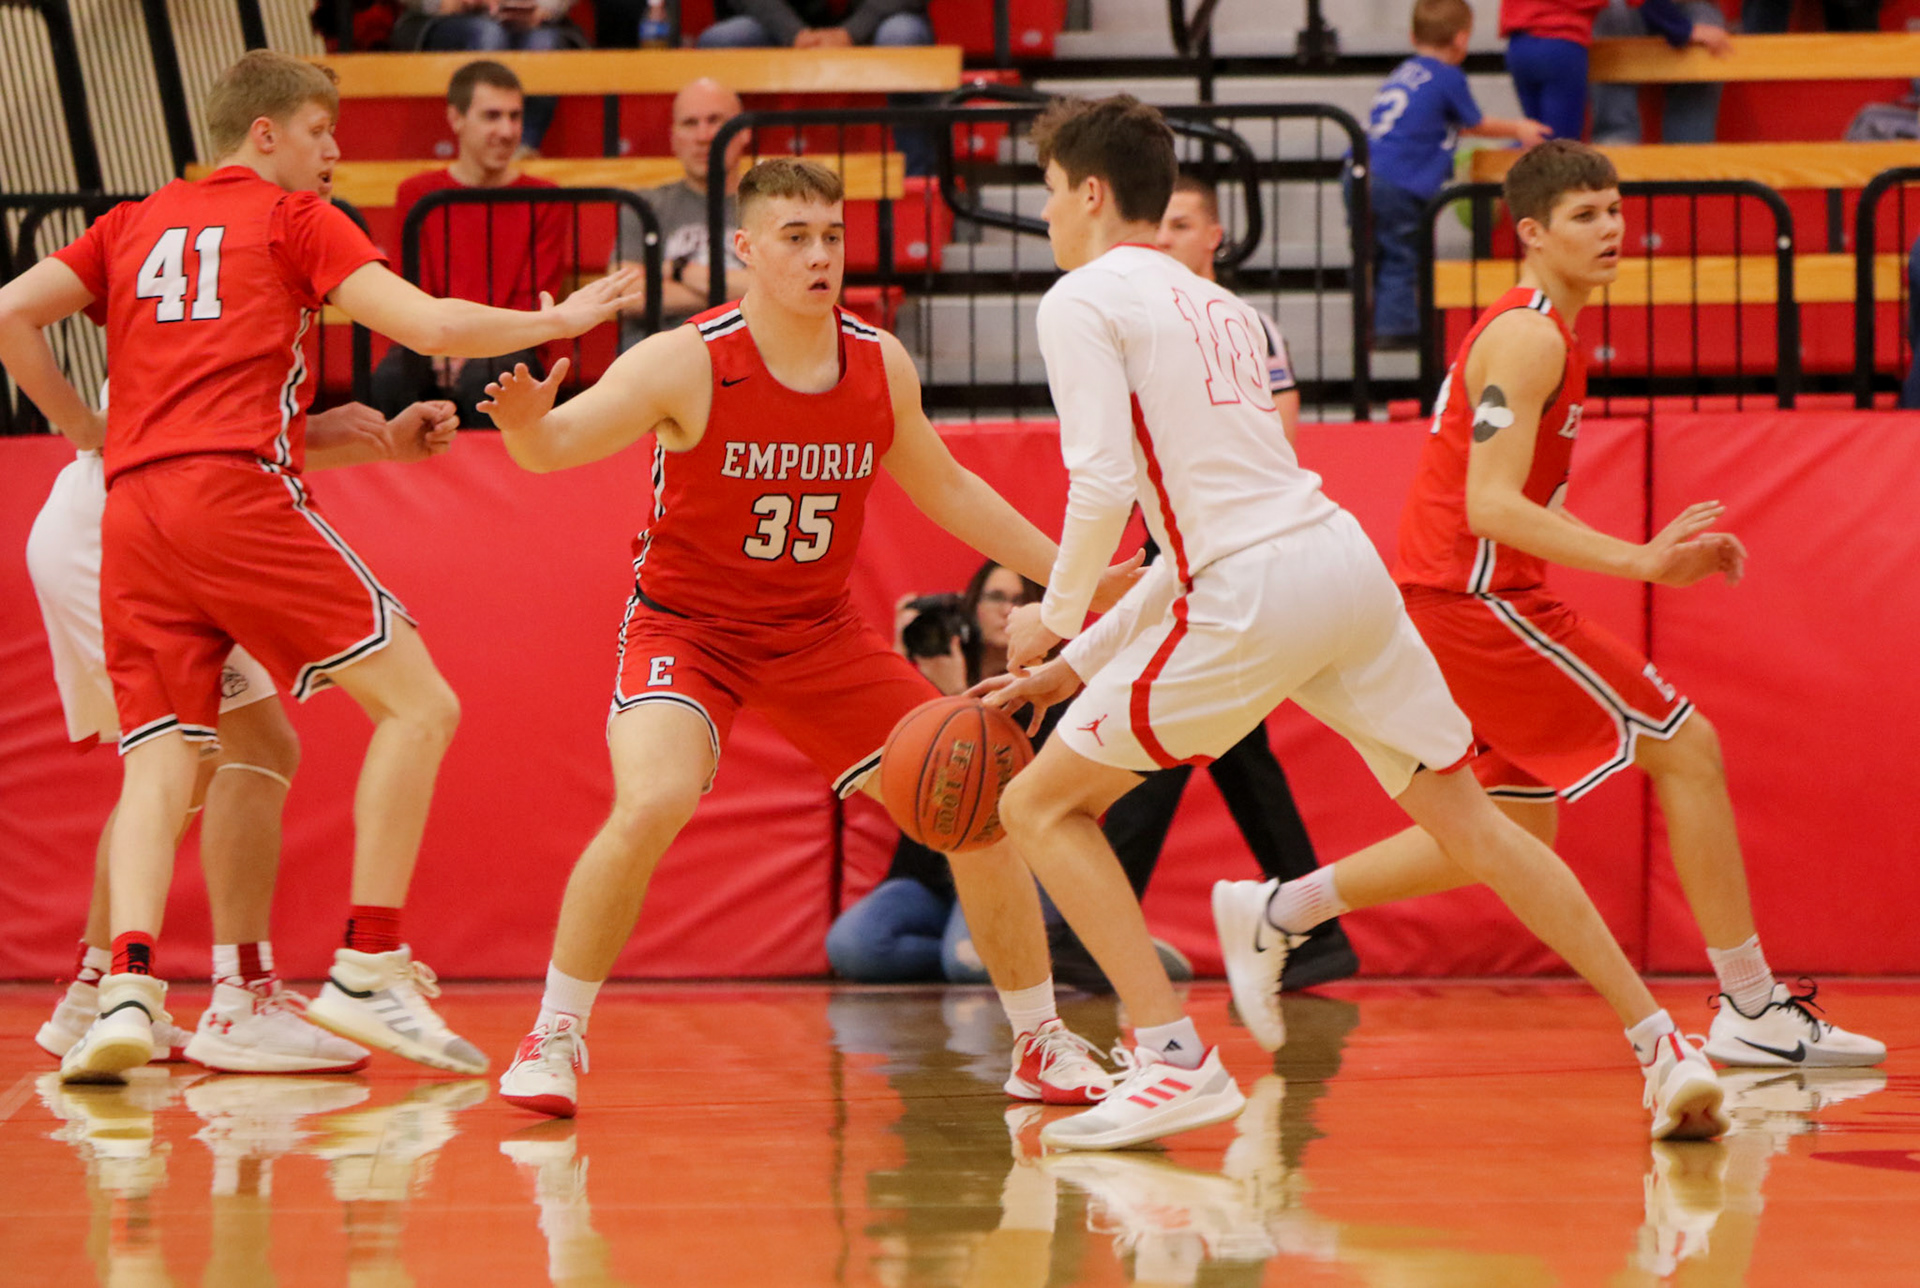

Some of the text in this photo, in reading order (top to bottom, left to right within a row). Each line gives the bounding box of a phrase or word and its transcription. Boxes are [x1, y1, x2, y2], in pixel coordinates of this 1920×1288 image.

[136, 225, 226, 323] 41
[1172, 286, 1277, 412] 10
[721, 441, 874, 480] EMPORIA
[743, 493, 841, 563] 35
[646, 655, 676, 687] E
